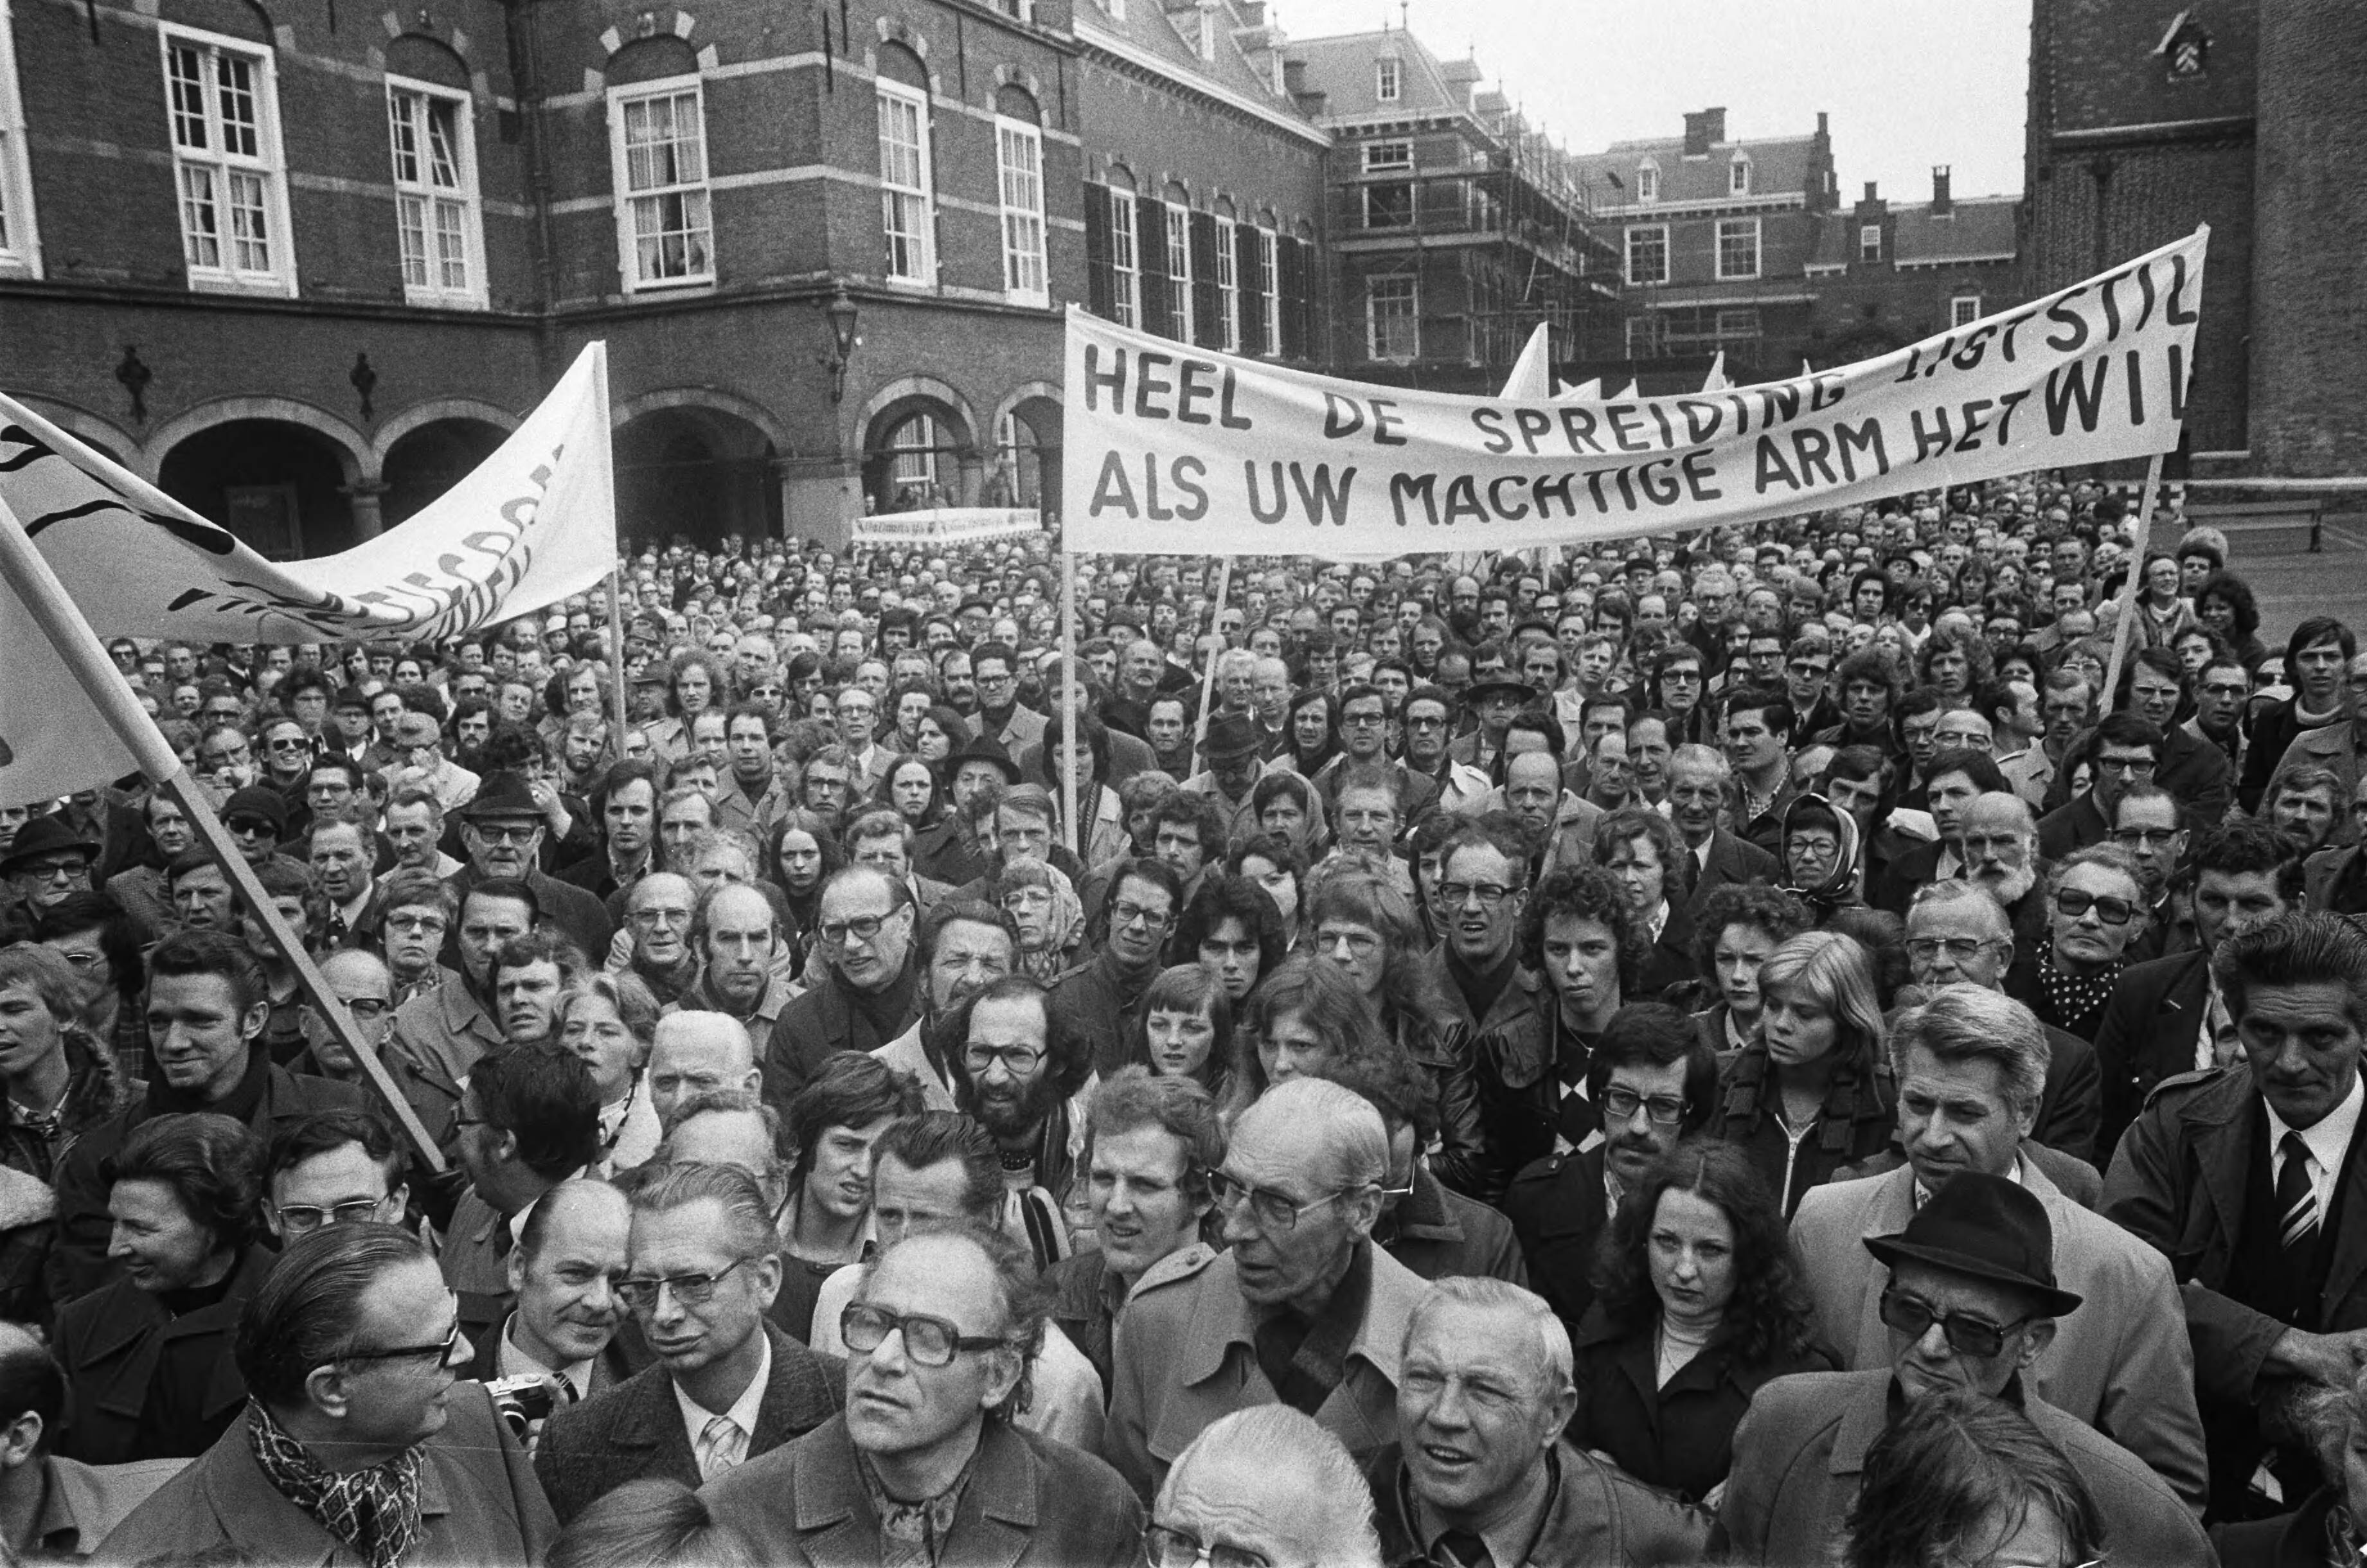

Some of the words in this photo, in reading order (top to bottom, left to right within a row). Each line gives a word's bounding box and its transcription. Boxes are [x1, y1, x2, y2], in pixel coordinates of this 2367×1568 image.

[1085, 344, 1252, 430] HEEL
[1322, 391, 1407, 446] DE
[1471, 373, 1846, 454] SPREIDING
[1894, 310, 2037, 383] LIGT
[2046, 255, 2197, 352] STIL
[1089, 450, 1209, 521] ALS
[1244, 460, 1357, 526] UW
[1389, 449, 1722, 526] MACHTIGE
[1755, 417, 1889, 494] ARM
[1911, 389, 2032, 464] HET
